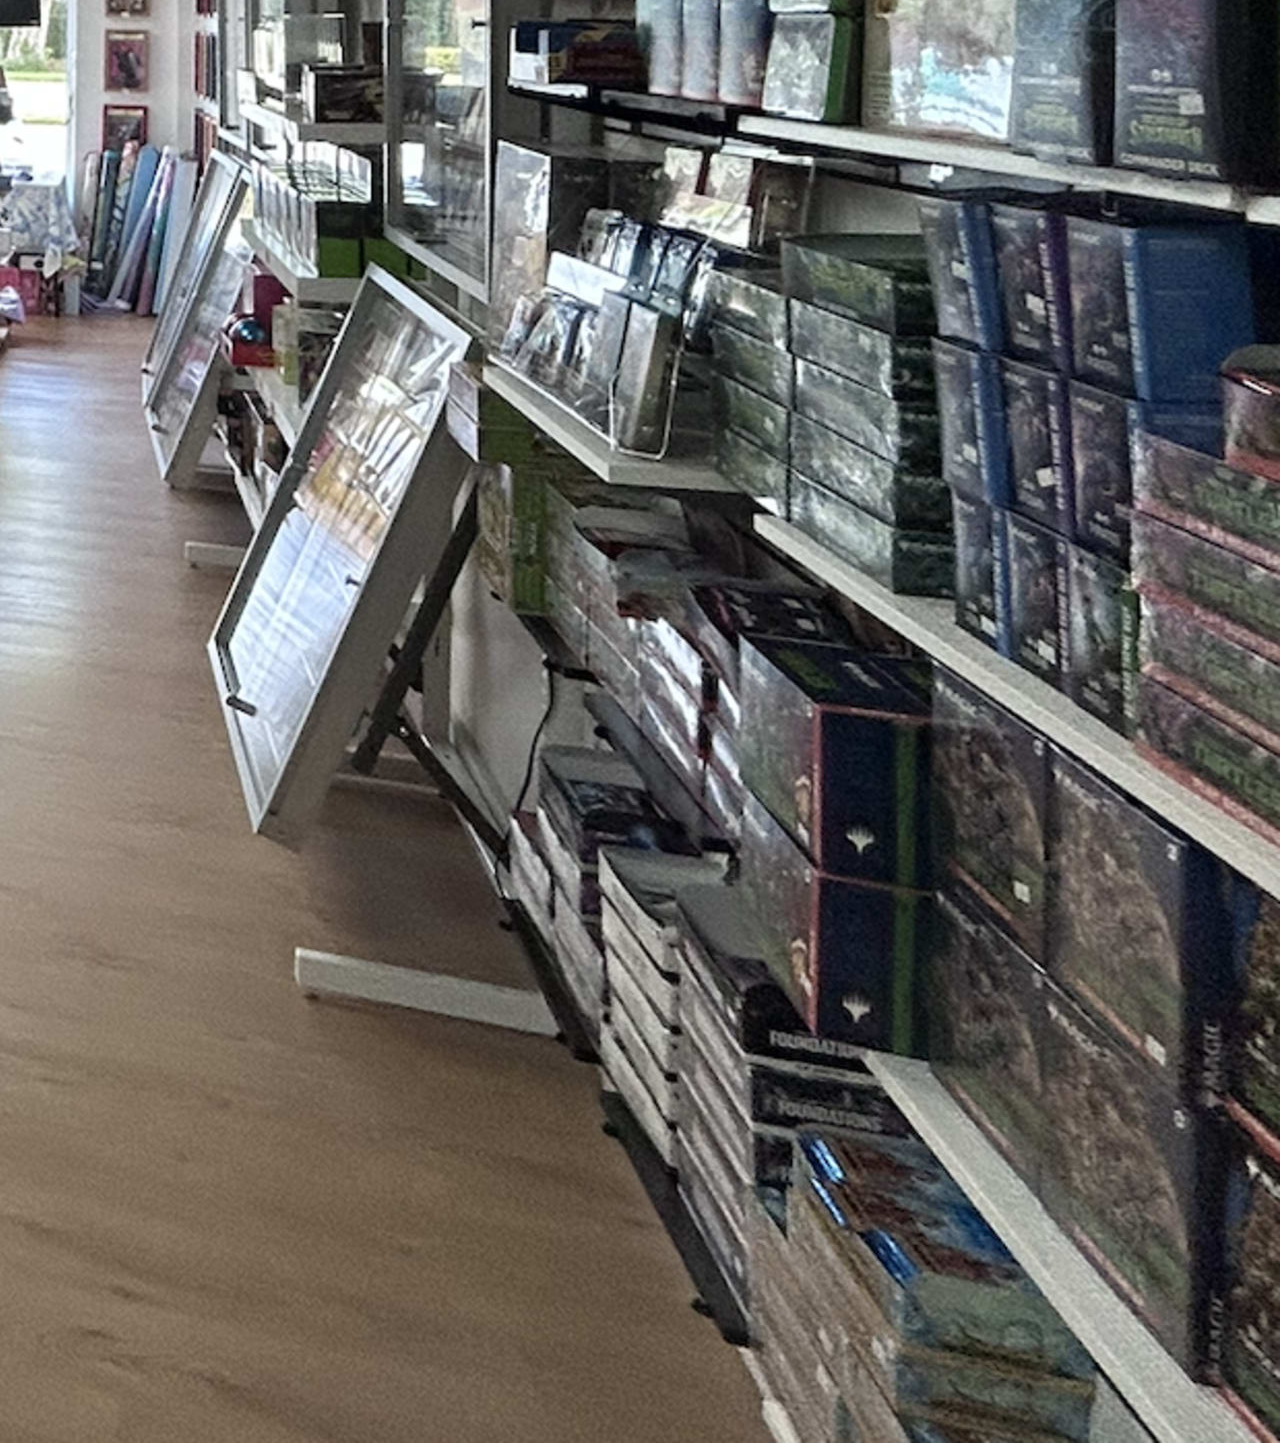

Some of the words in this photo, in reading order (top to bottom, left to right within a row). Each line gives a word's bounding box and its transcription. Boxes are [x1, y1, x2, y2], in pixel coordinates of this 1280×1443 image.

[1121, 152, 1186, 171] COMMANDER
[1187, 160, 1220, 177] DECK
[1202, 1015, 1223, 1093] MAGIC
[777, 1099, 883, 1132] FOUNDATIONS
